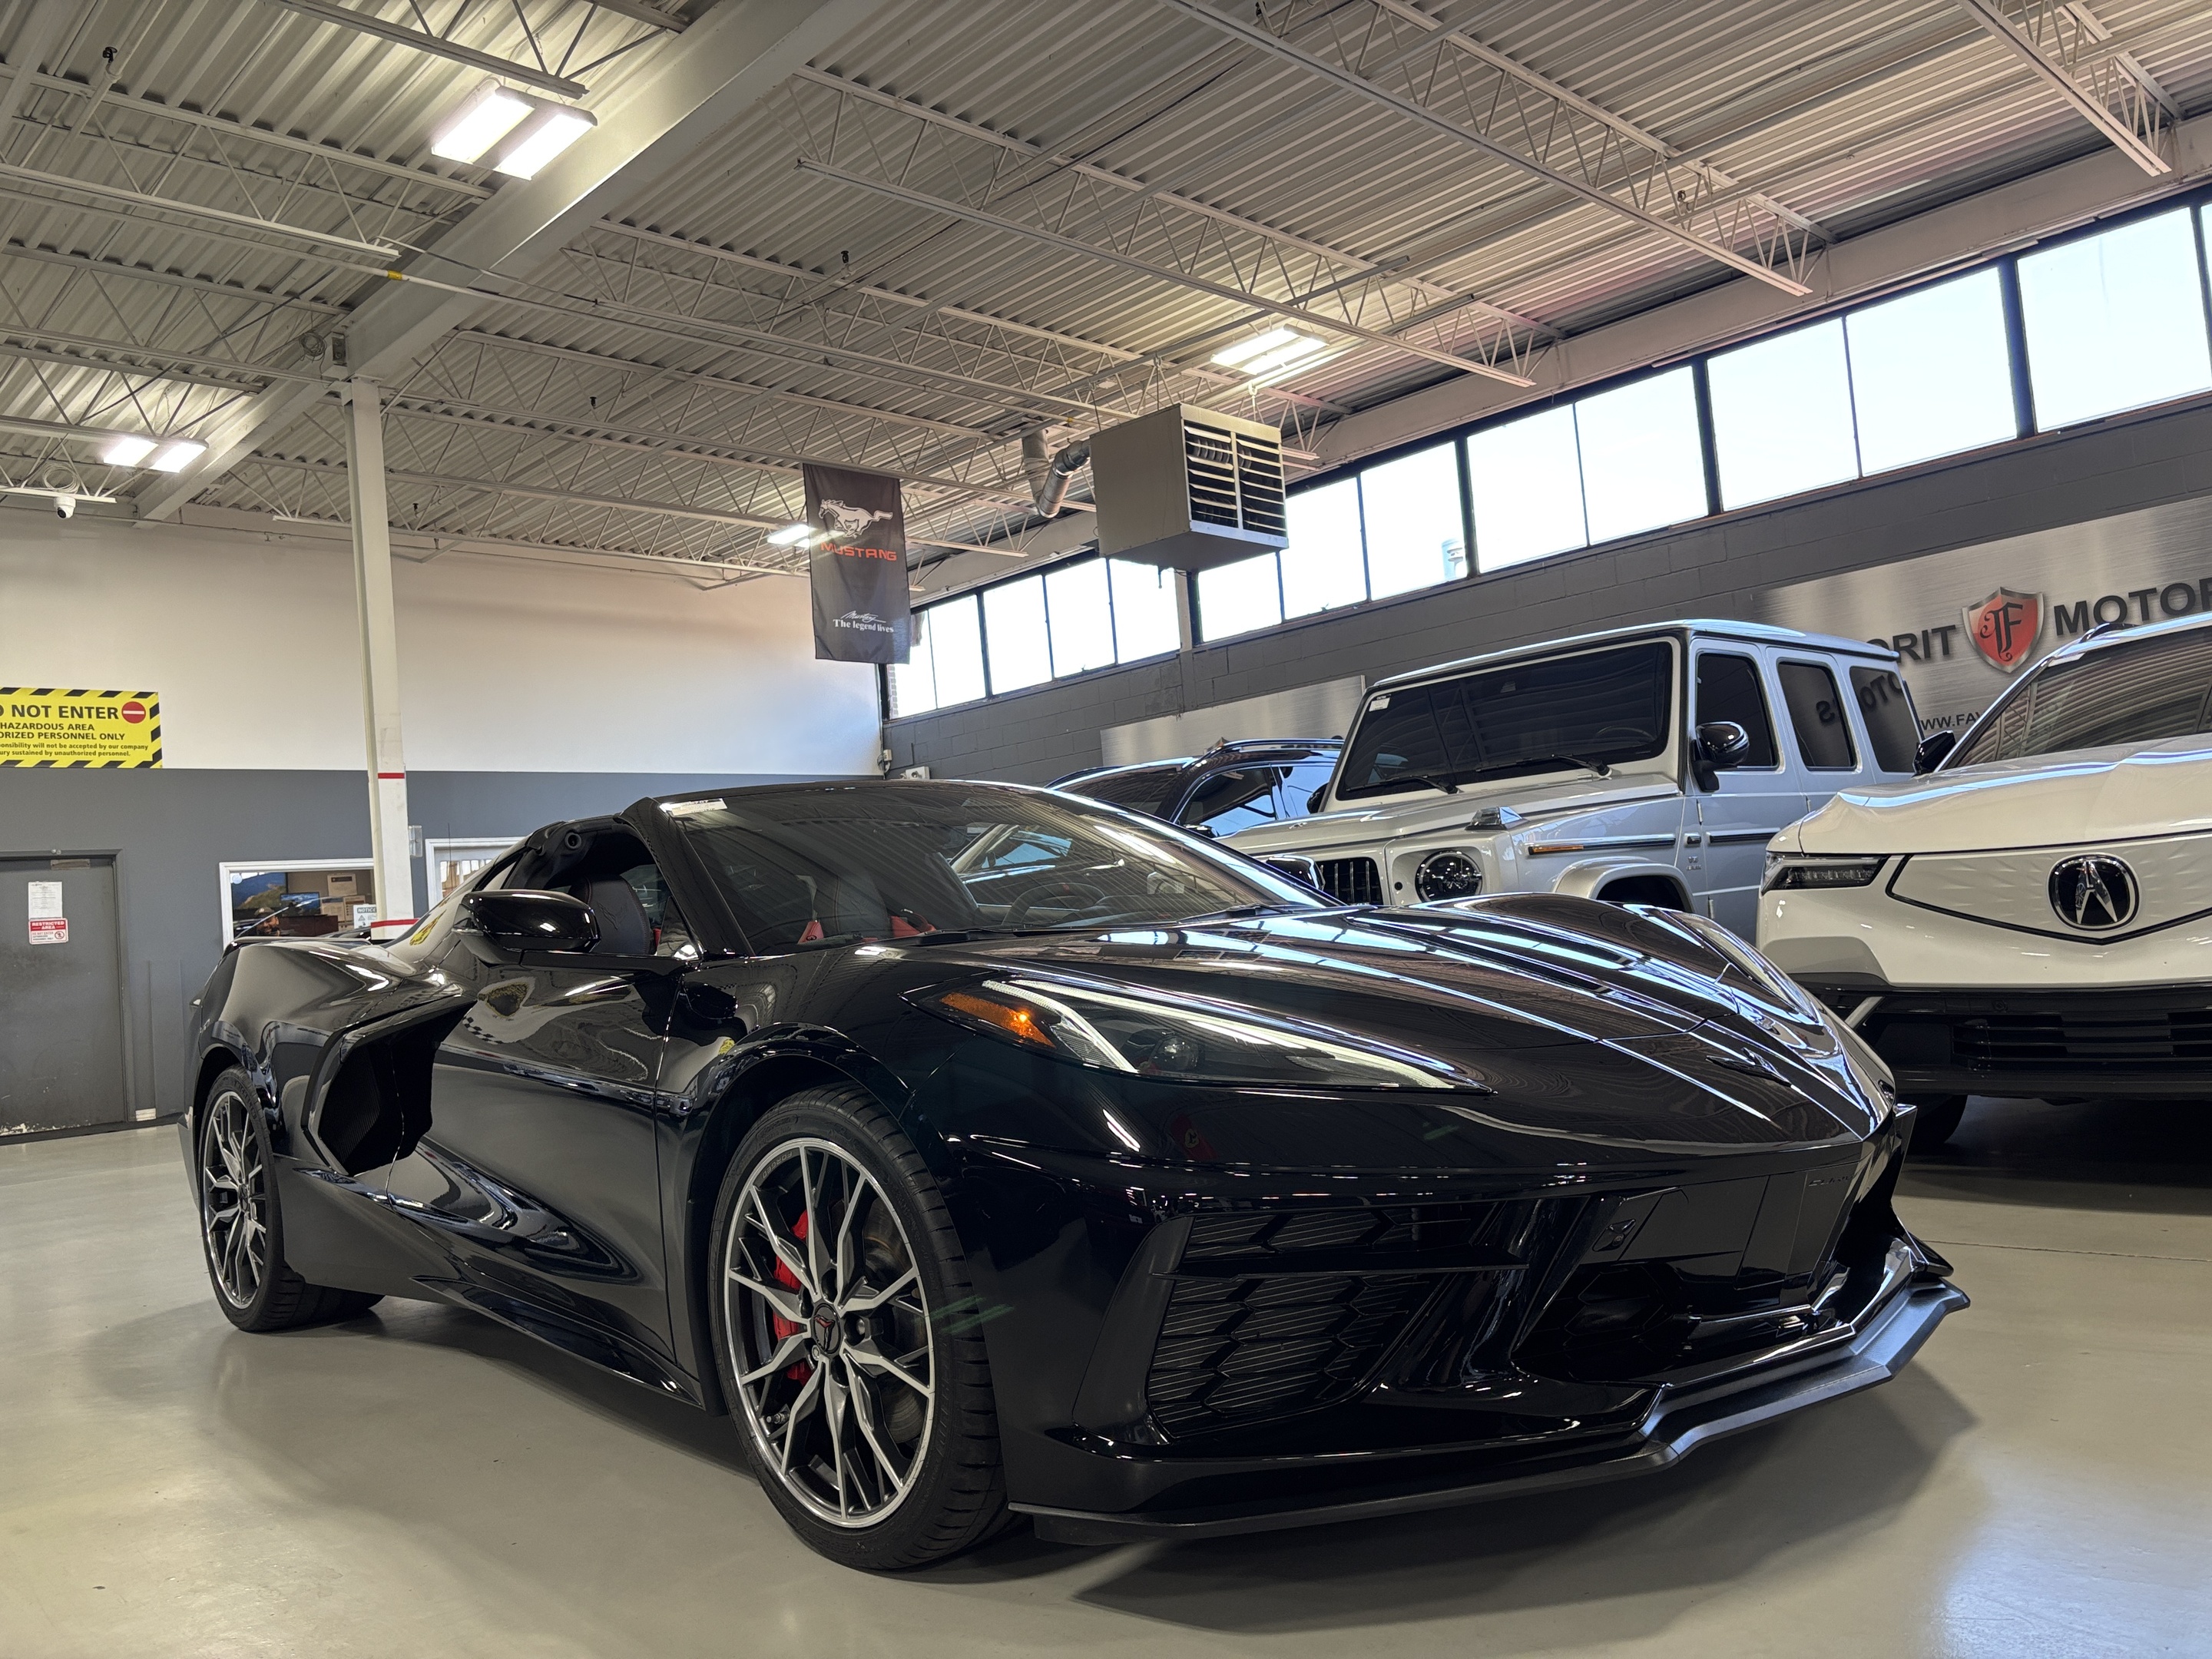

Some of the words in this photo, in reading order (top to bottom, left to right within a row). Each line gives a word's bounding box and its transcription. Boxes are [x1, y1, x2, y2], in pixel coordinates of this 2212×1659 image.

[821, 542, 897, 561] MUSTANG
[833, 619, 851, 628] The
[853, 621, 876, 631] legend
[877, 624, 894, 633] lives
[12, 704, 51, 717] NOT
[58, 705, 119, 719] ENTER
[0, 722, 64, 730] HAZARDOUS
[762, 1151, 793, 1179] FORGED
